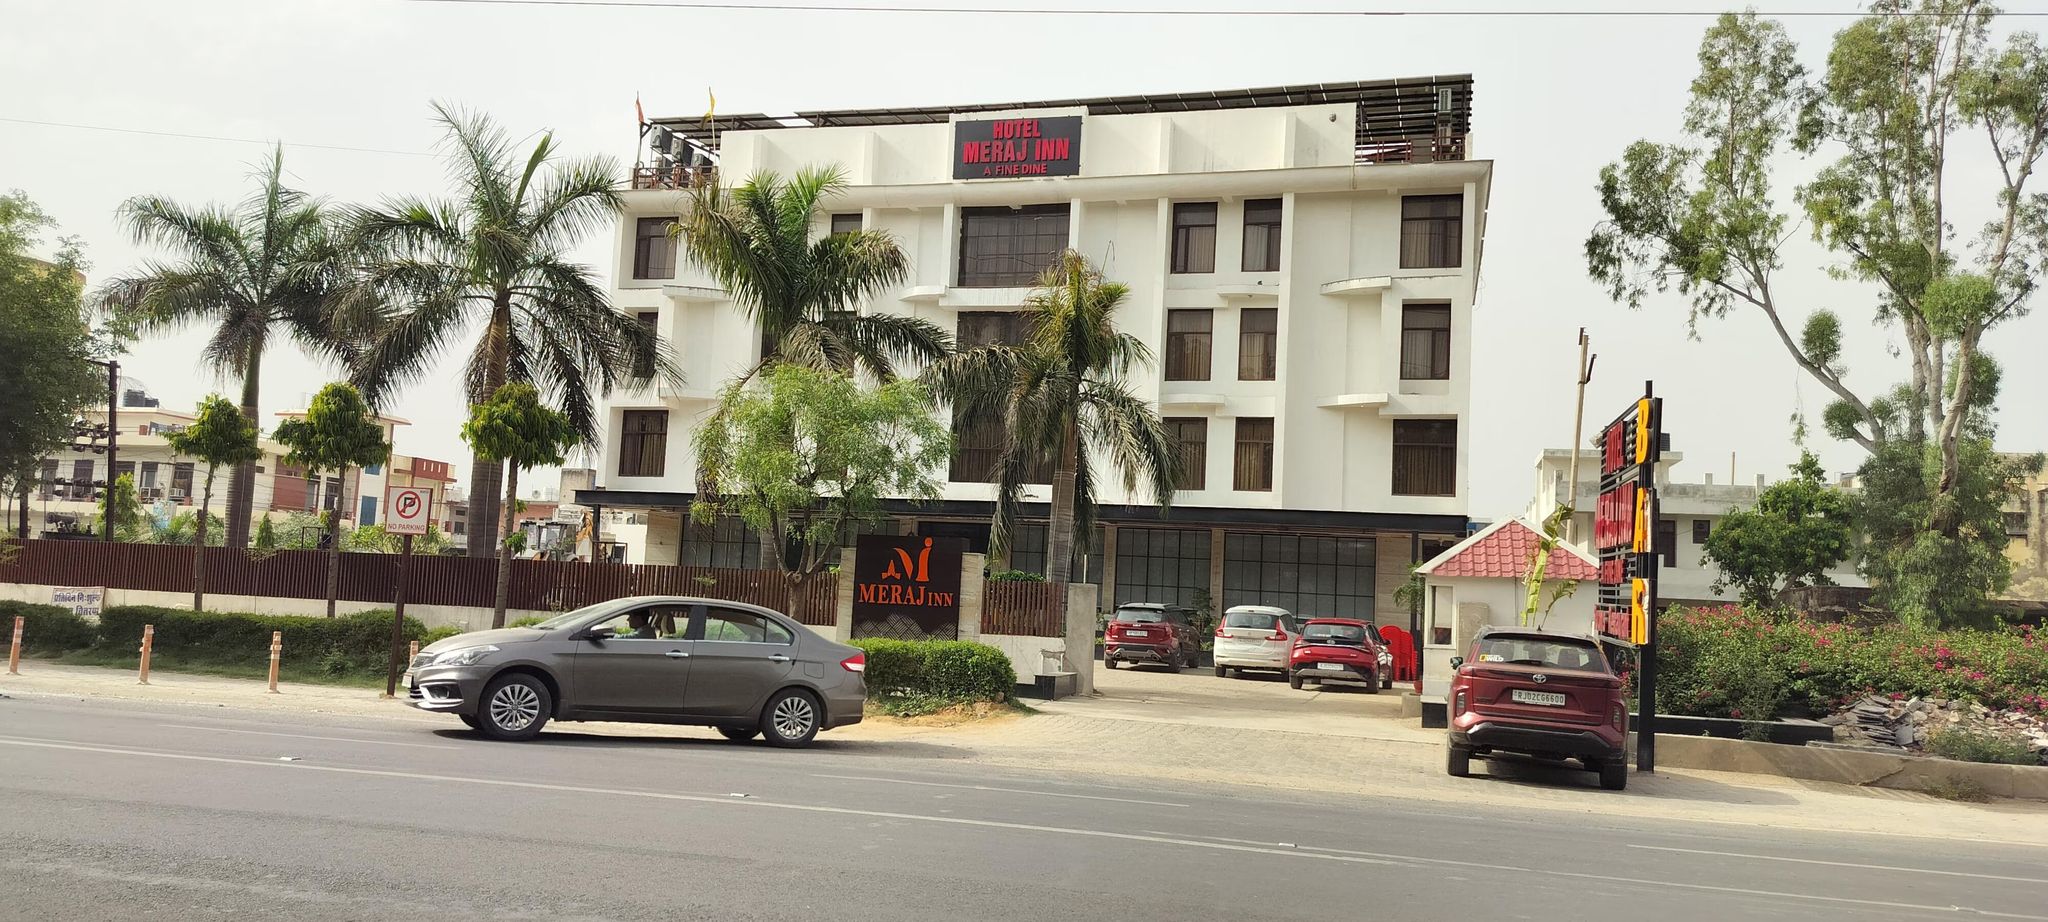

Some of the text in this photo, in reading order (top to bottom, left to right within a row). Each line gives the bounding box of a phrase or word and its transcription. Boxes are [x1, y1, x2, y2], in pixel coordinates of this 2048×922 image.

[993, 119, 1041, 139] HOTEL
[963, 140, 1027, 164] MERAJ
[984, 163, 1047, 176] A FINE DINE
[399, 523, 425, 531] PARKING
[858, 583, 953, 607] MERAJ INN
